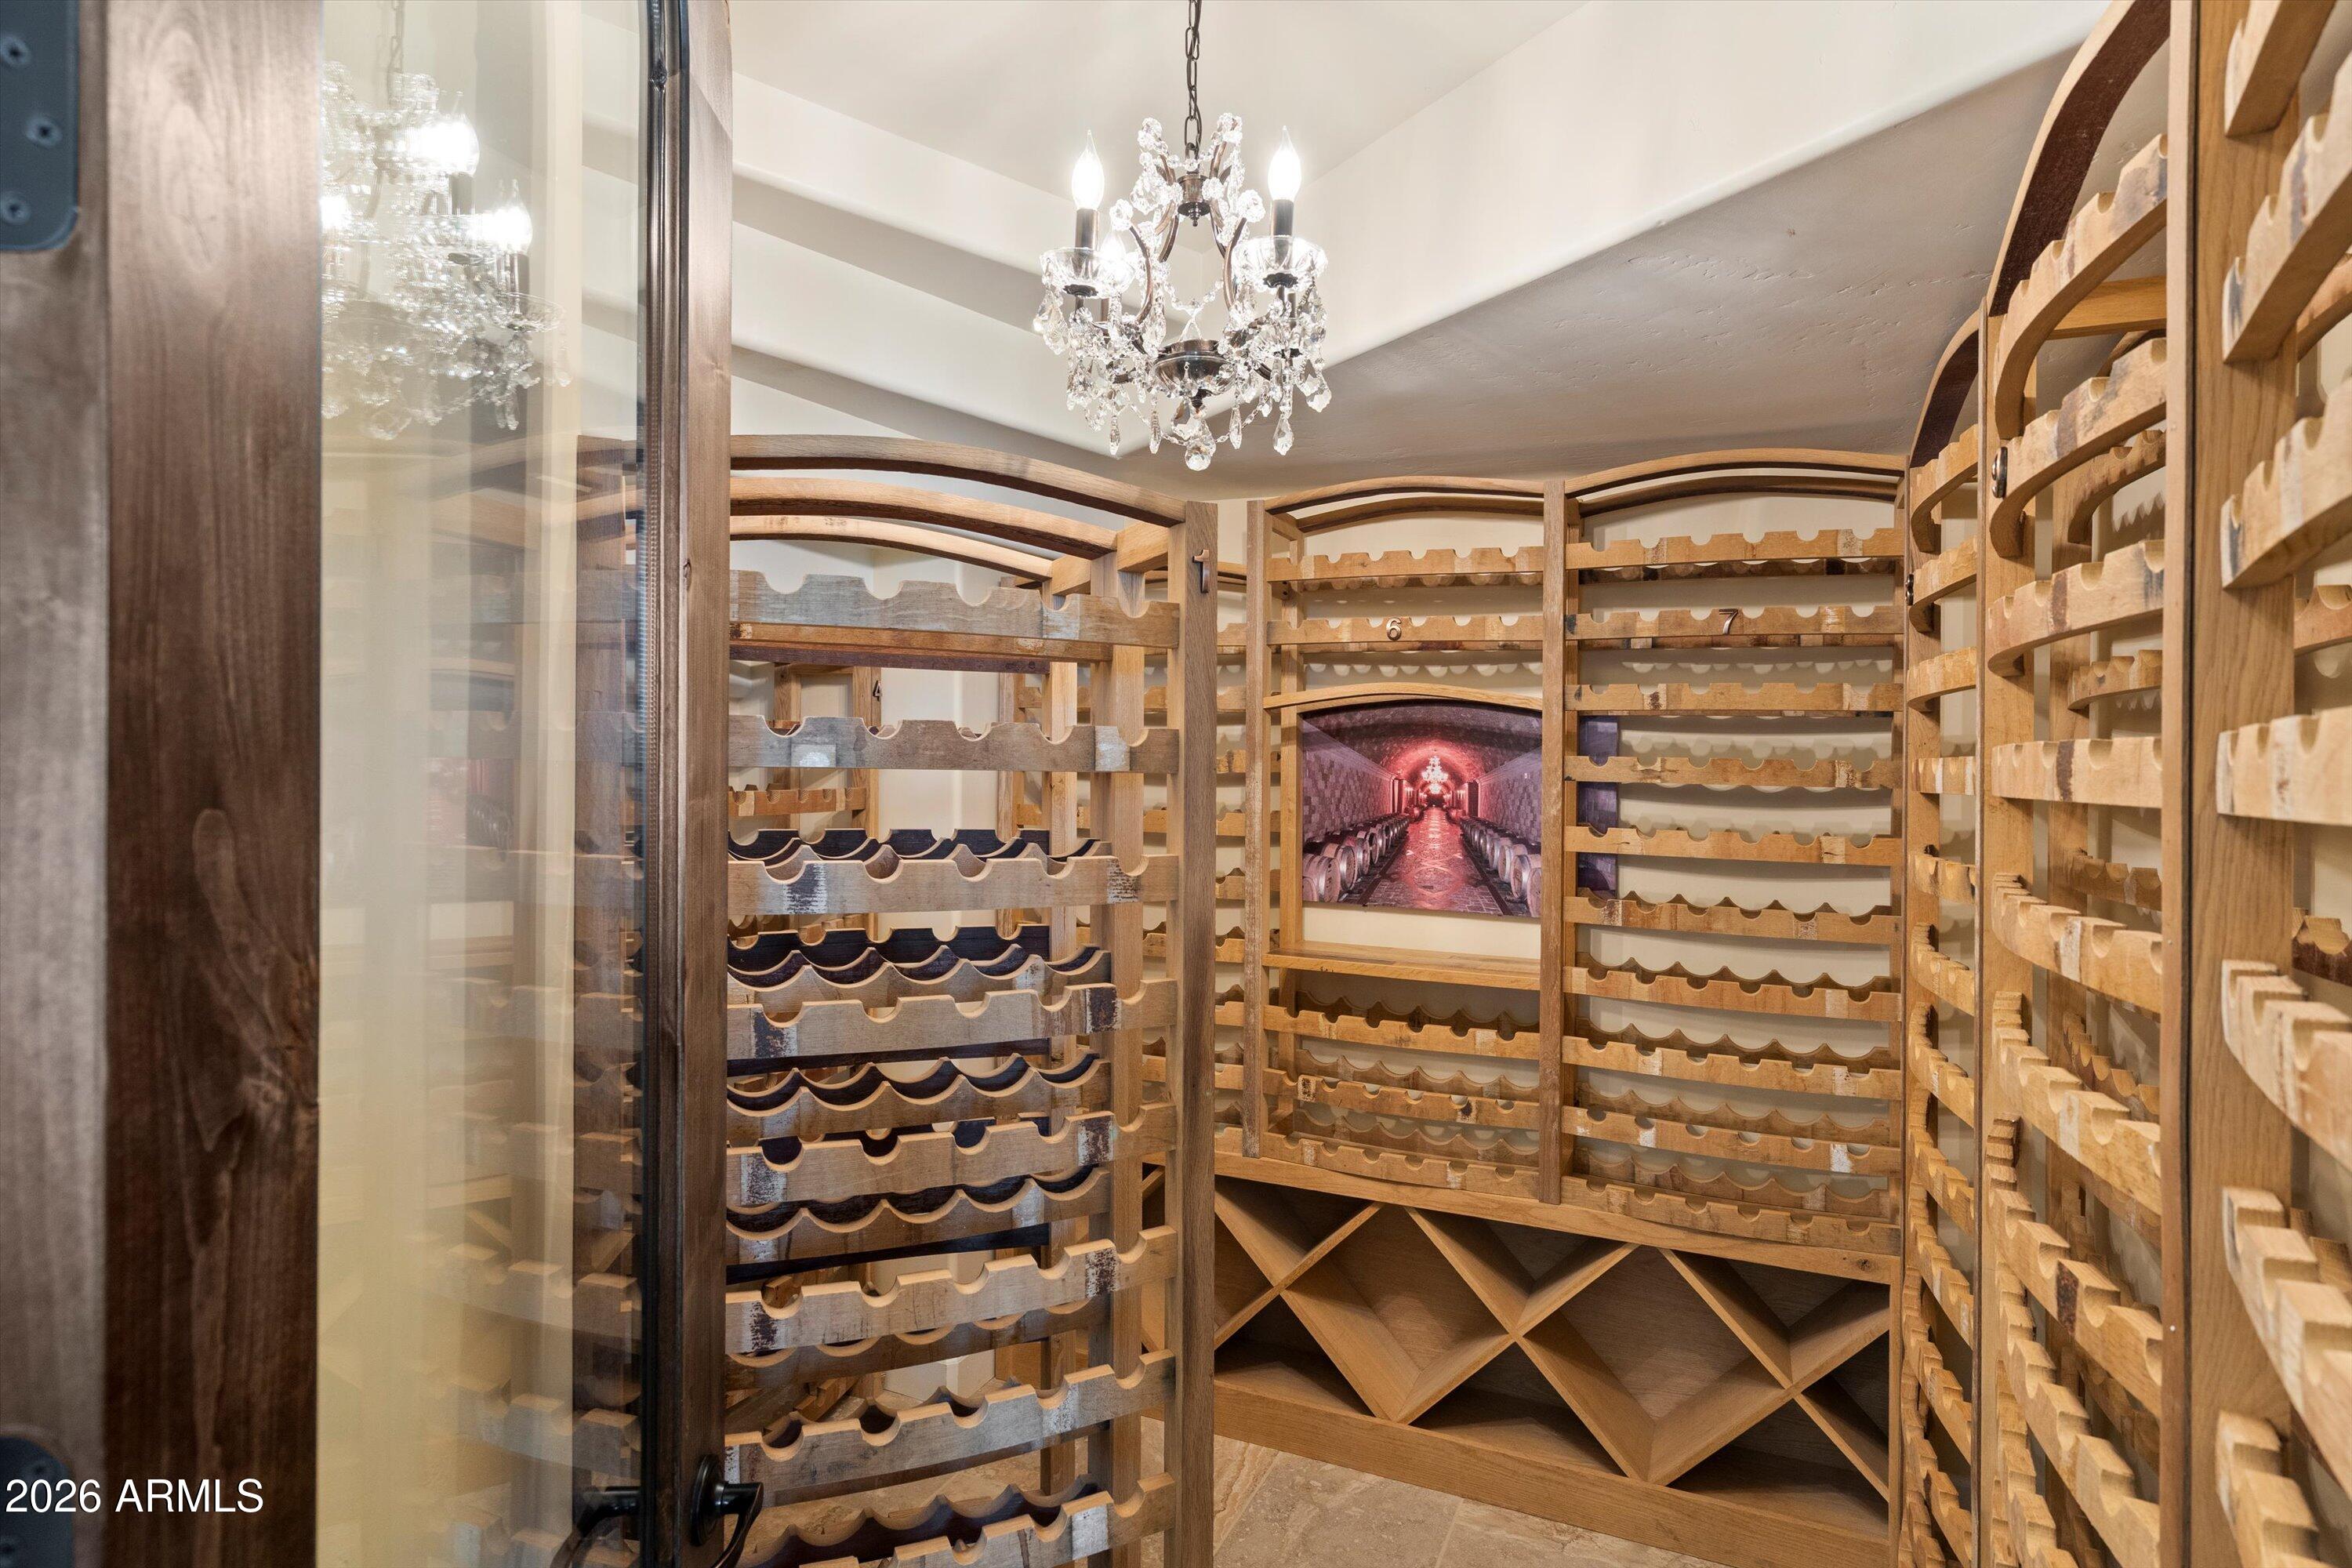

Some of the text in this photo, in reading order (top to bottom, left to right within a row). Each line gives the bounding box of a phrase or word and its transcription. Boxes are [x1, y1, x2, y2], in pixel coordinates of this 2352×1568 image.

[1386, 617, 1402, 641] 6
[1719, 608, 1738, 635] 7
[873, 680, 883, 702] 4
